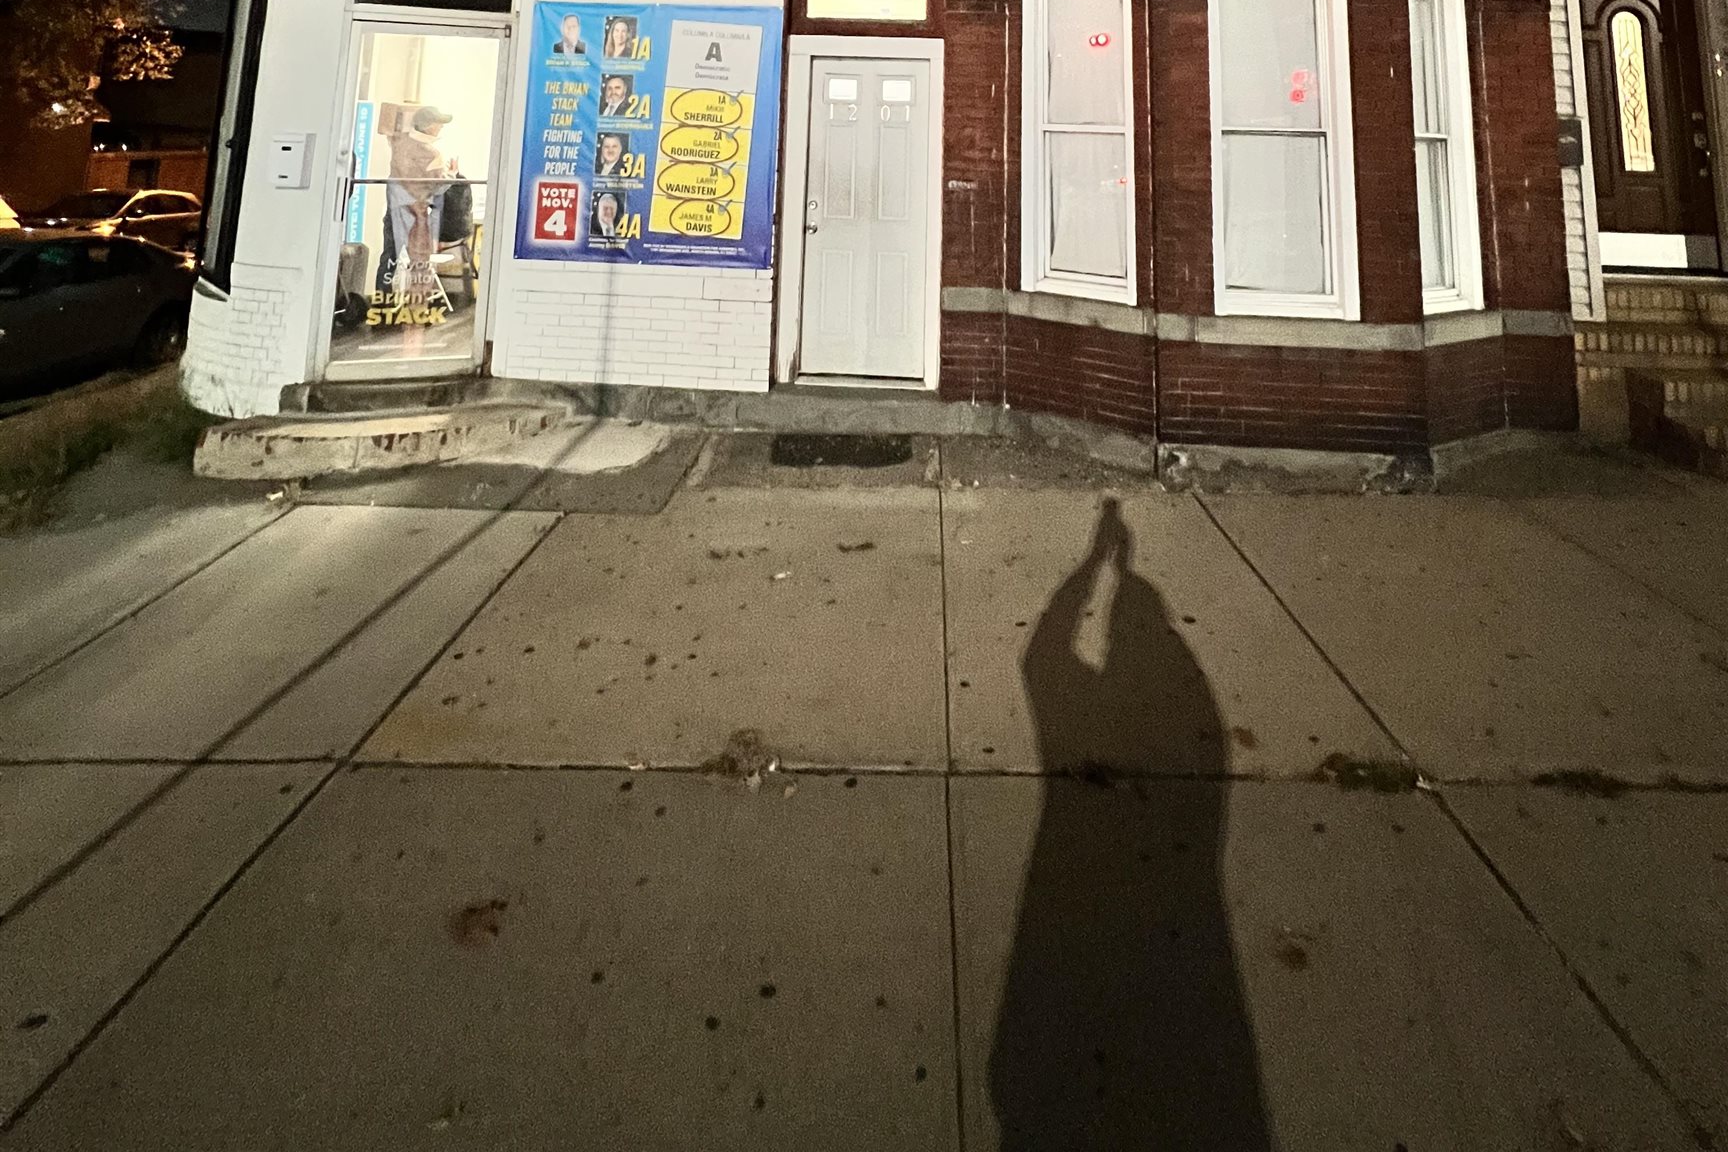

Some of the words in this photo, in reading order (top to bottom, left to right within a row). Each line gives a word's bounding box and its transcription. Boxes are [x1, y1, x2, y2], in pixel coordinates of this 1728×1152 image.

[631, 35, 651, 61] 1A
[704, 41, 722, 63] A
[545, 81, 560, 94] THE
[552, 97, 579, 111] STACK
[625, 94, 651, 119] 2A
[718, 95, 726, 105] 1A
[684, 112, 723, 124] SHERRILL
[829, 103, 910, 121] 1201
[550, 113, 573, 127] TEAM
[543, 129, 583, 144] FIGHTING
[714, 131, 722, 141] 2A
[544, 145, 561, 159] FOR
[563, 146, 579, 160] THE
[671, 146, 721, 160] RODRIGUEZ
[544, 161, 577, 176] PEOPLE
[620, 153, 646, 179] 3A
[541, 187, 577, 199] VOTE
[666, 183, 717, 196] WAINSTEIN
[542, 198, 573, 208] NOV.
[706, 204, 714, 214] 4A
[543, 209, 568, 236] 4
[615, 213, 641, 239] 4A
[685, 222, 713, 233] DAVIS
[366, 307, 447, 326] STACK
